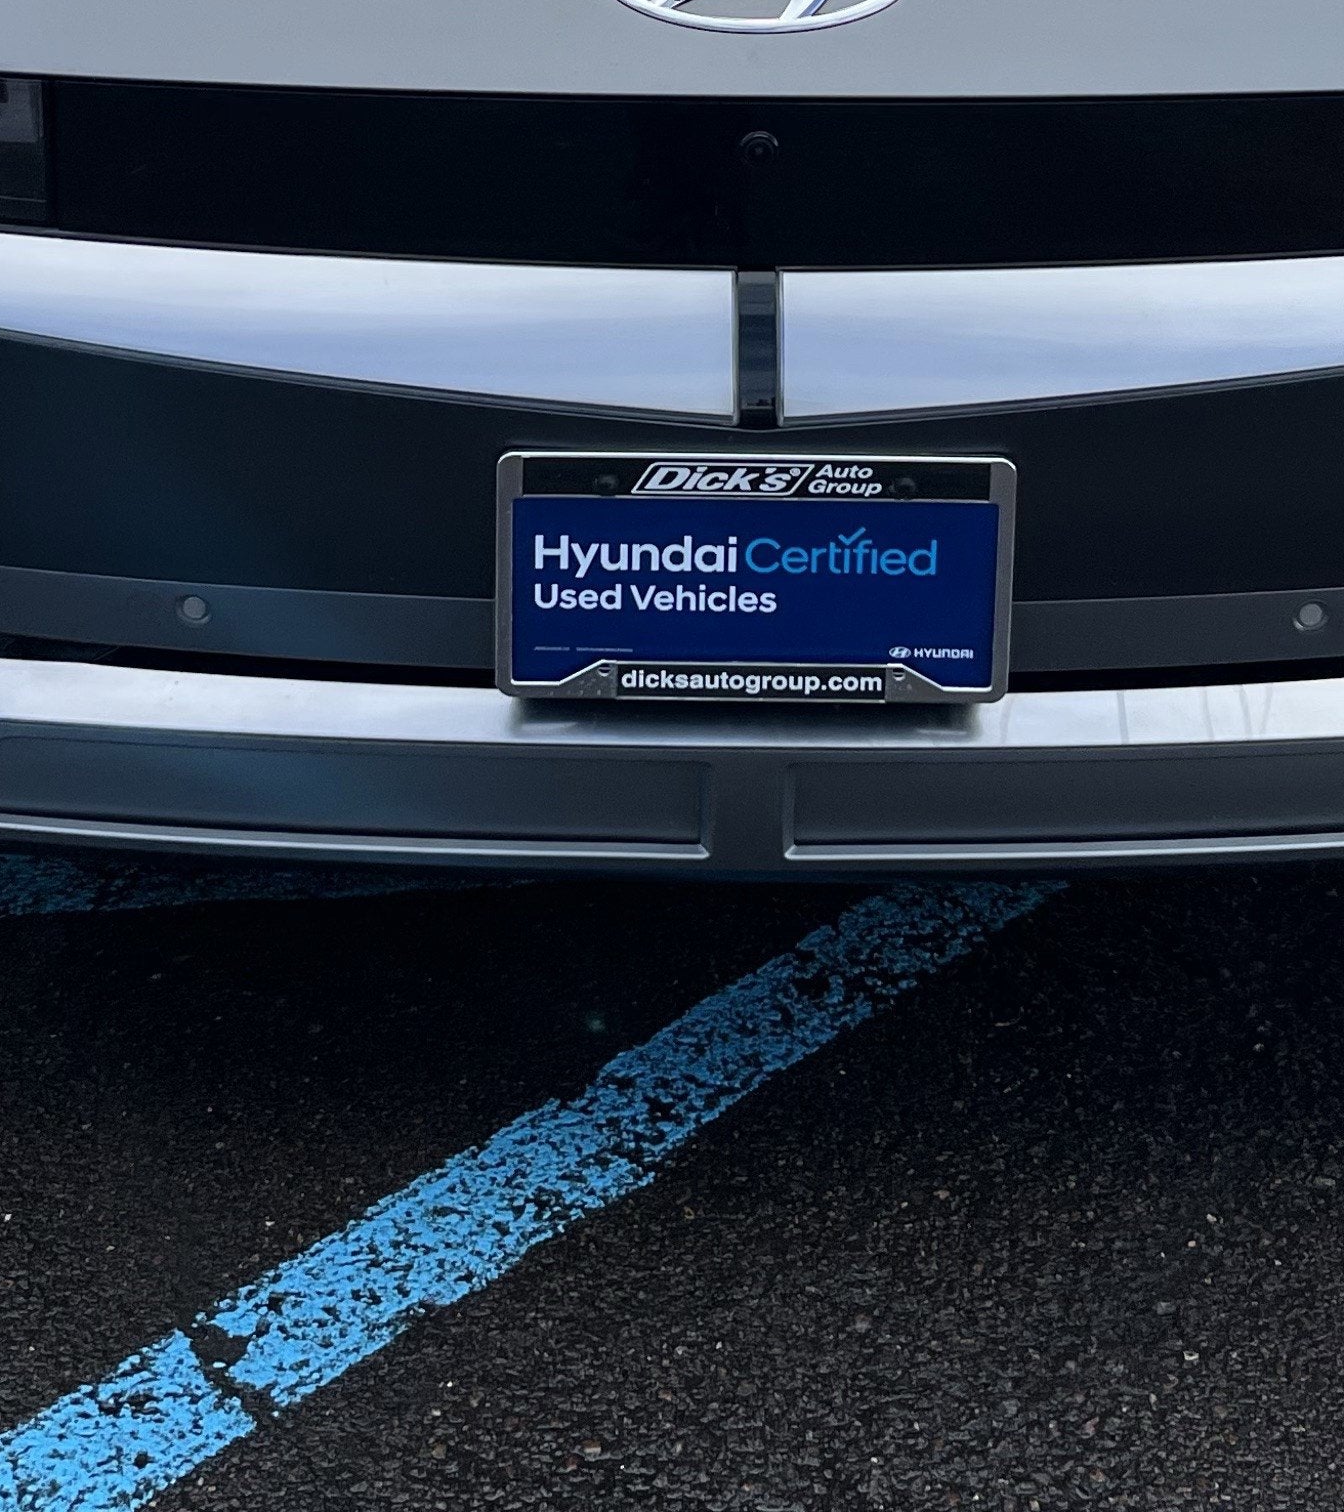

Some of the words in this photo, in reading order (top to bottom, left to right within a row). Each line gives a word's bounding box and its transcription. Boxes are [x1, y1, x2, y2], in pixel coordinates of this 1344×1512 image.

[644, 466, 792, 492] Dick's
[815, 464, 874, 479] Auto
[807, 479, 883, 497] Group
[534, 534, 738, 579] Hyundai
[744, 527, 938, 576] Certified
[534, 583, 623, 611] Used
[629, 584, 778, 614] Vehicles
[913, 647, 974, 660] HYUNDAI
[620, 668, 883, 695] dicksautogroup.com
